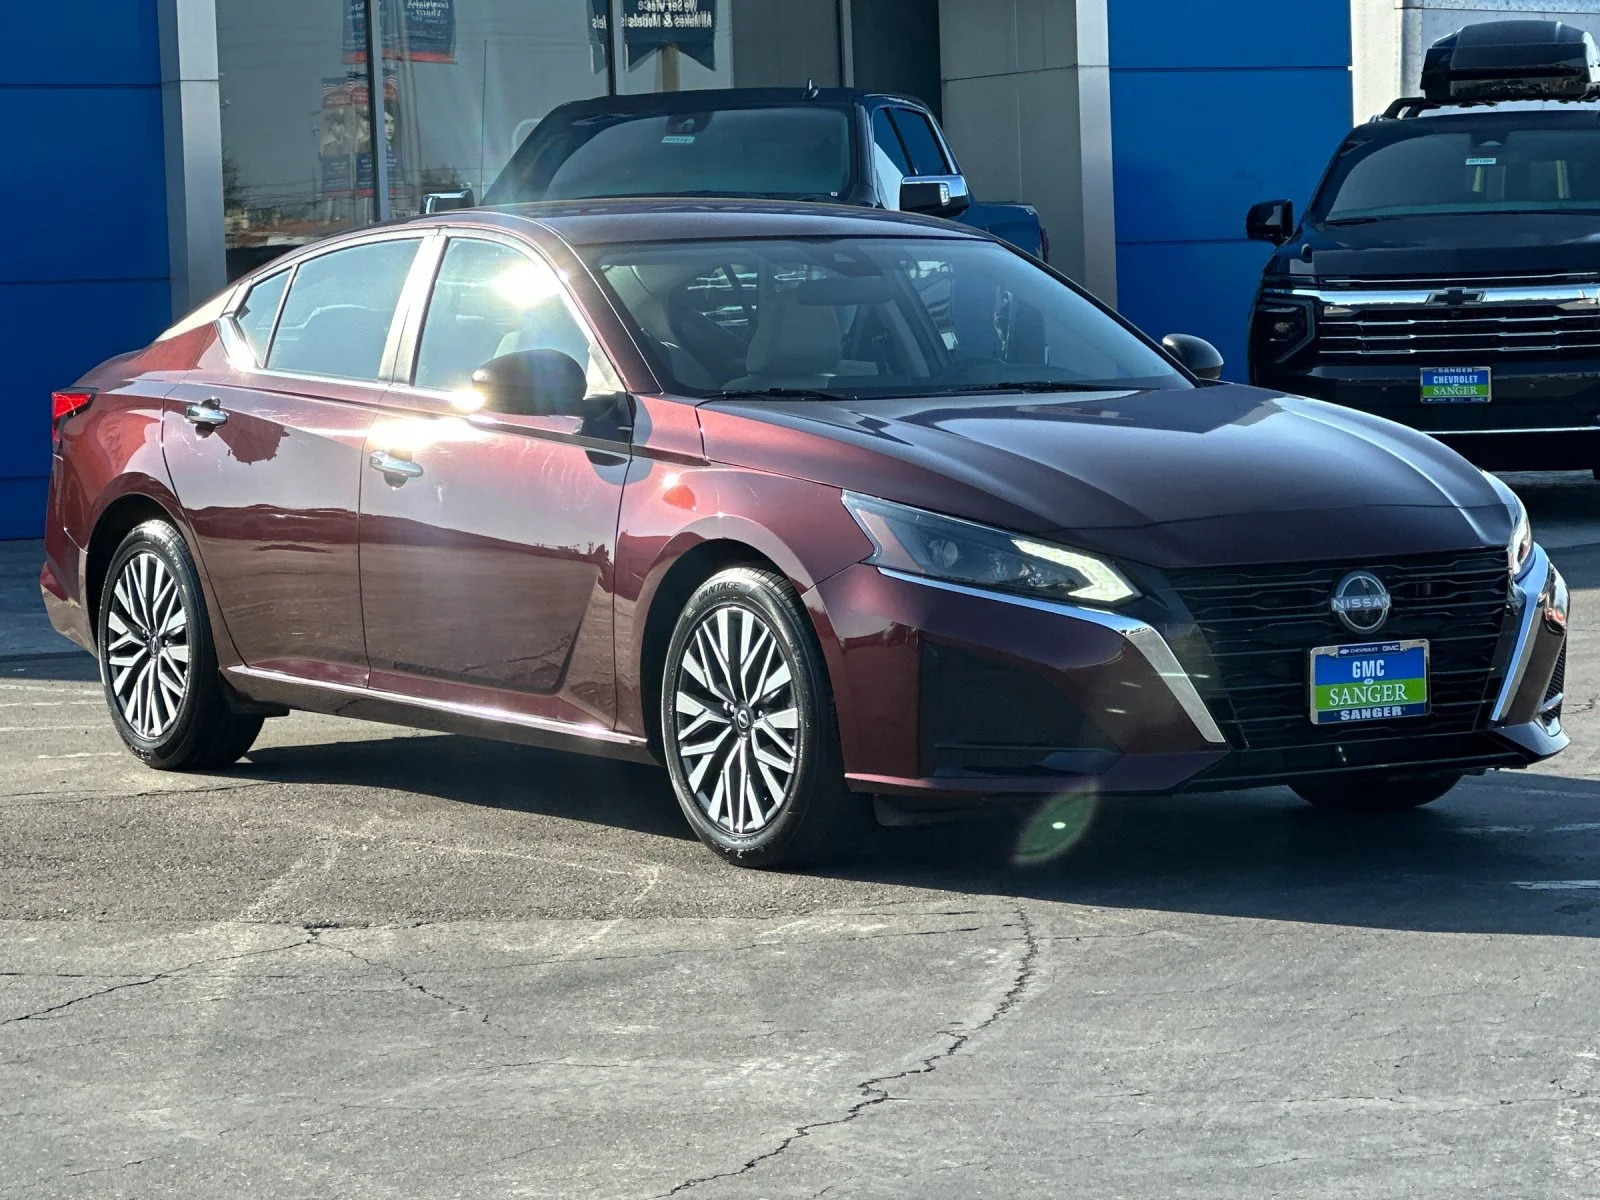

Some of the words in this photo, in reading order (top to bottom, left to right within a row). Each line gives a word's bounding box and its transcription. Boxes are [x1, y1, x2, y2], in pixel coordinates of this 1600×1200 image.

[1433, 375, 1478, 384] CHEVROLET
[1433, 386, 1479, 396] SANGER
[698, 581, 741, 602] VANTAGE
[1333, 597, 1391, 610] NISSAN
[1350, 646, 1378, 654] CHEVROLET
[1382, 644, 1399, 652] GMC
[1352, 659, 1385, 678] GMC
[1329, 683, 1408, 706] SANGER
[1340, 705, 1402, 721] SANGER
